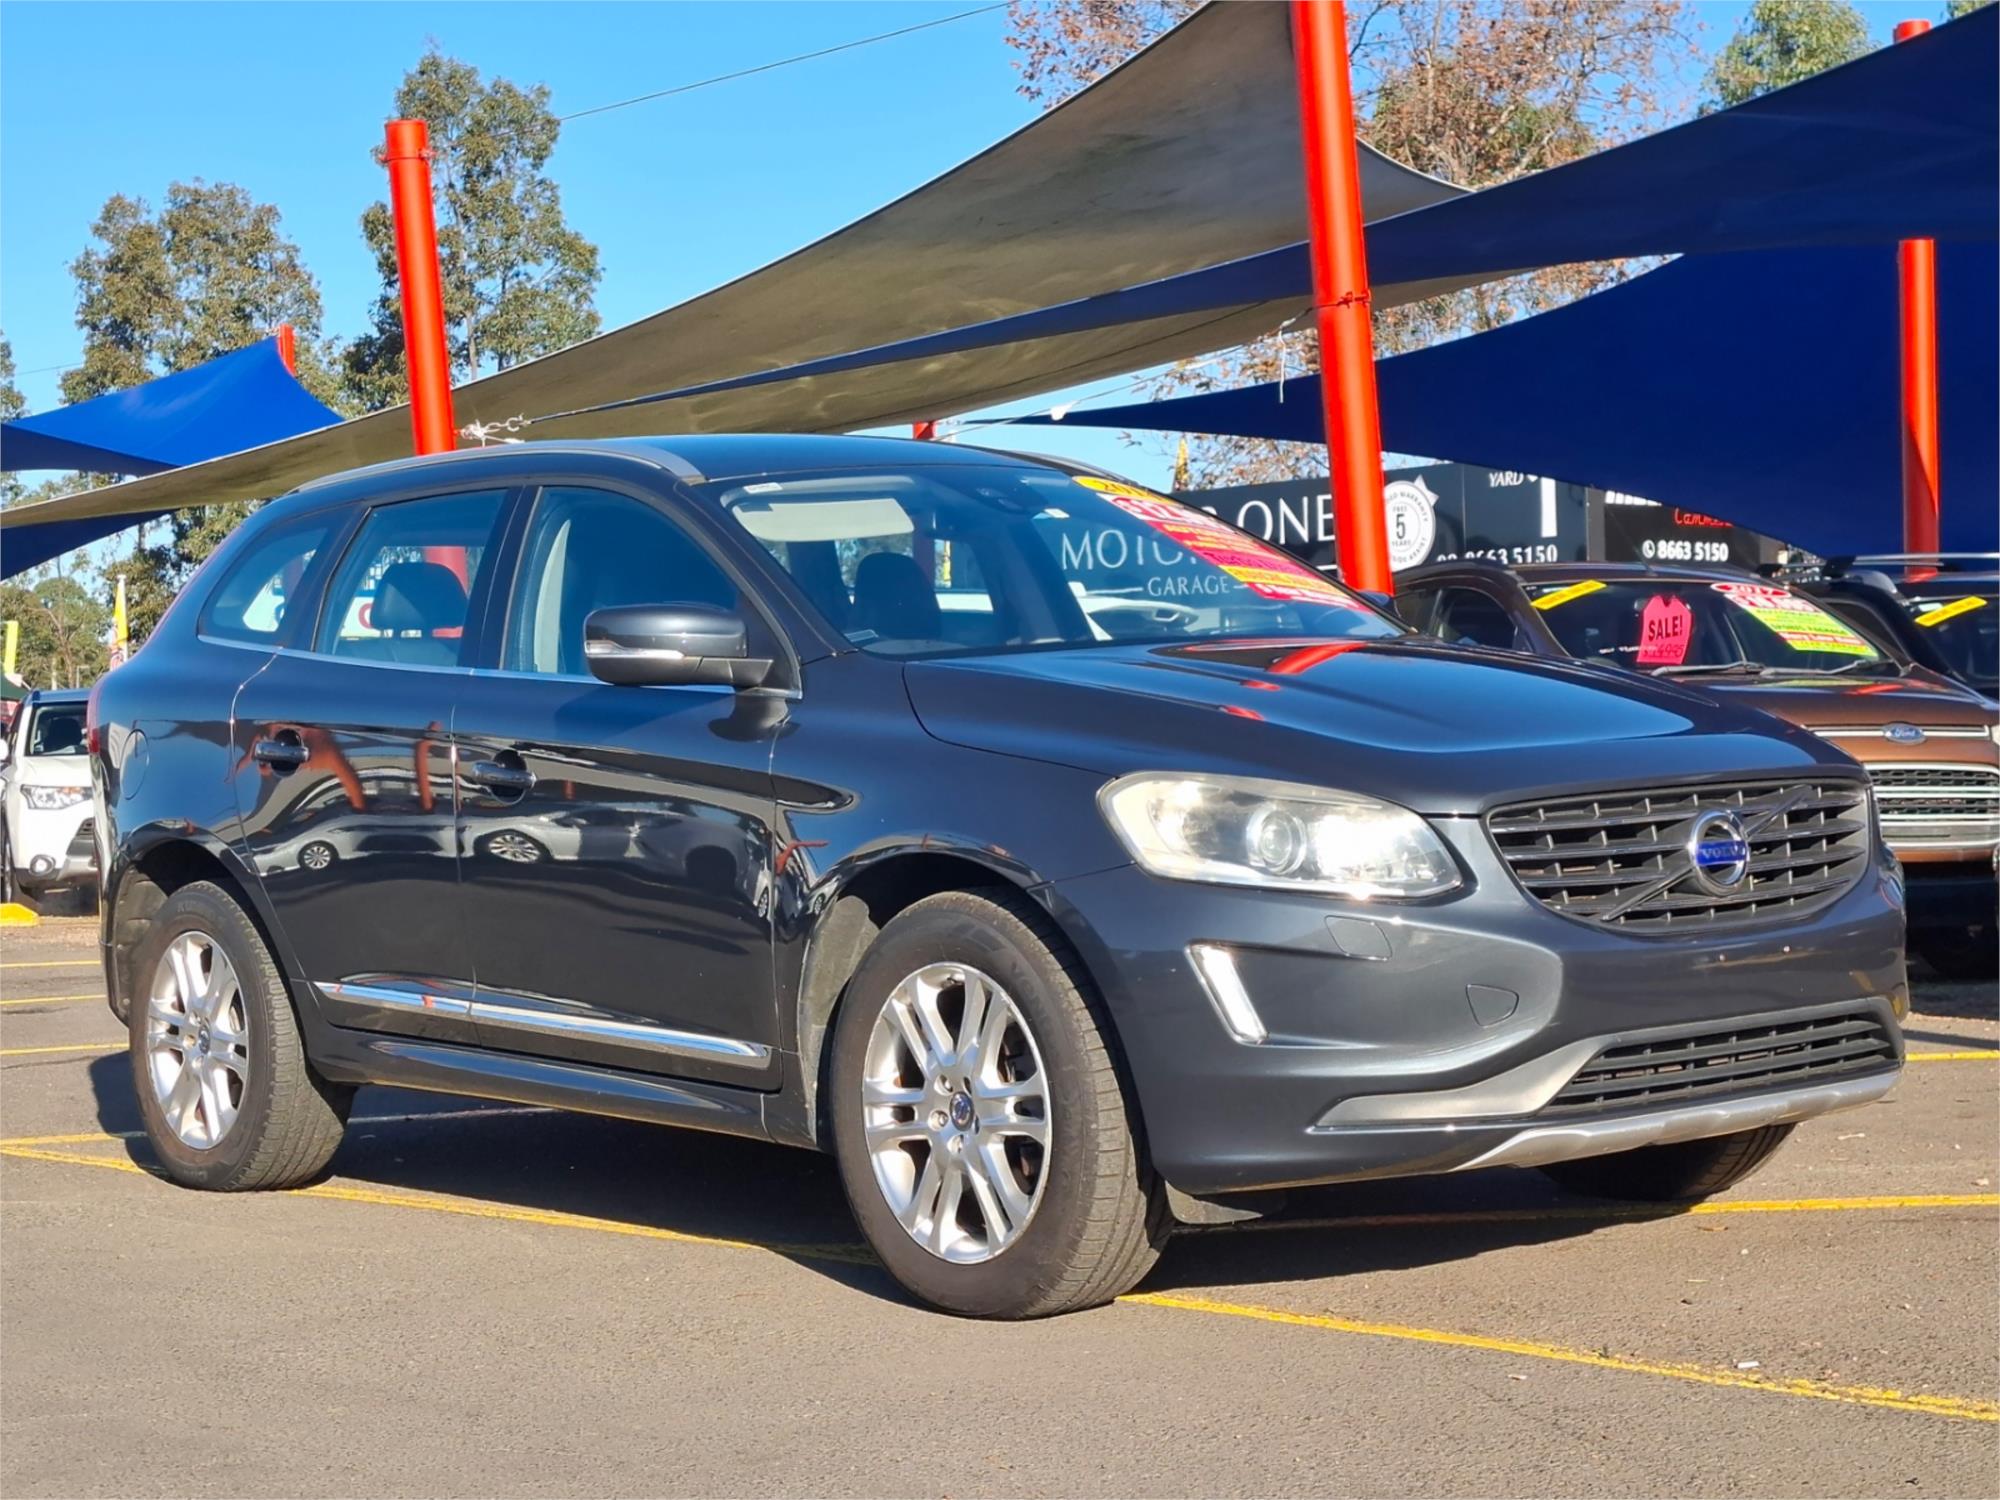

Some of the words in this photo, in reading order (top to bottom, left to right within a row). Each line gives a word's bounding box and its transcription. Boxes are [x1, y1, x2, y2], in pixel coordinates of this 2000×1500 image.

[1488, 471, 1524, 487] YARD
[1237, 494, 1336, 545] ONE
[1396, 513, 1406, 540] 5
[1513, 544, 1558, 564] 5150
[1657, 540, 1691, 560] 8663
[1694, 542, 1729, 562] 5150
[1148, 575, 1230, 597] GARAGE
[1648, 615, 1683, 642] SALE!
[1699, 845, 1746, 859] VOLVO
